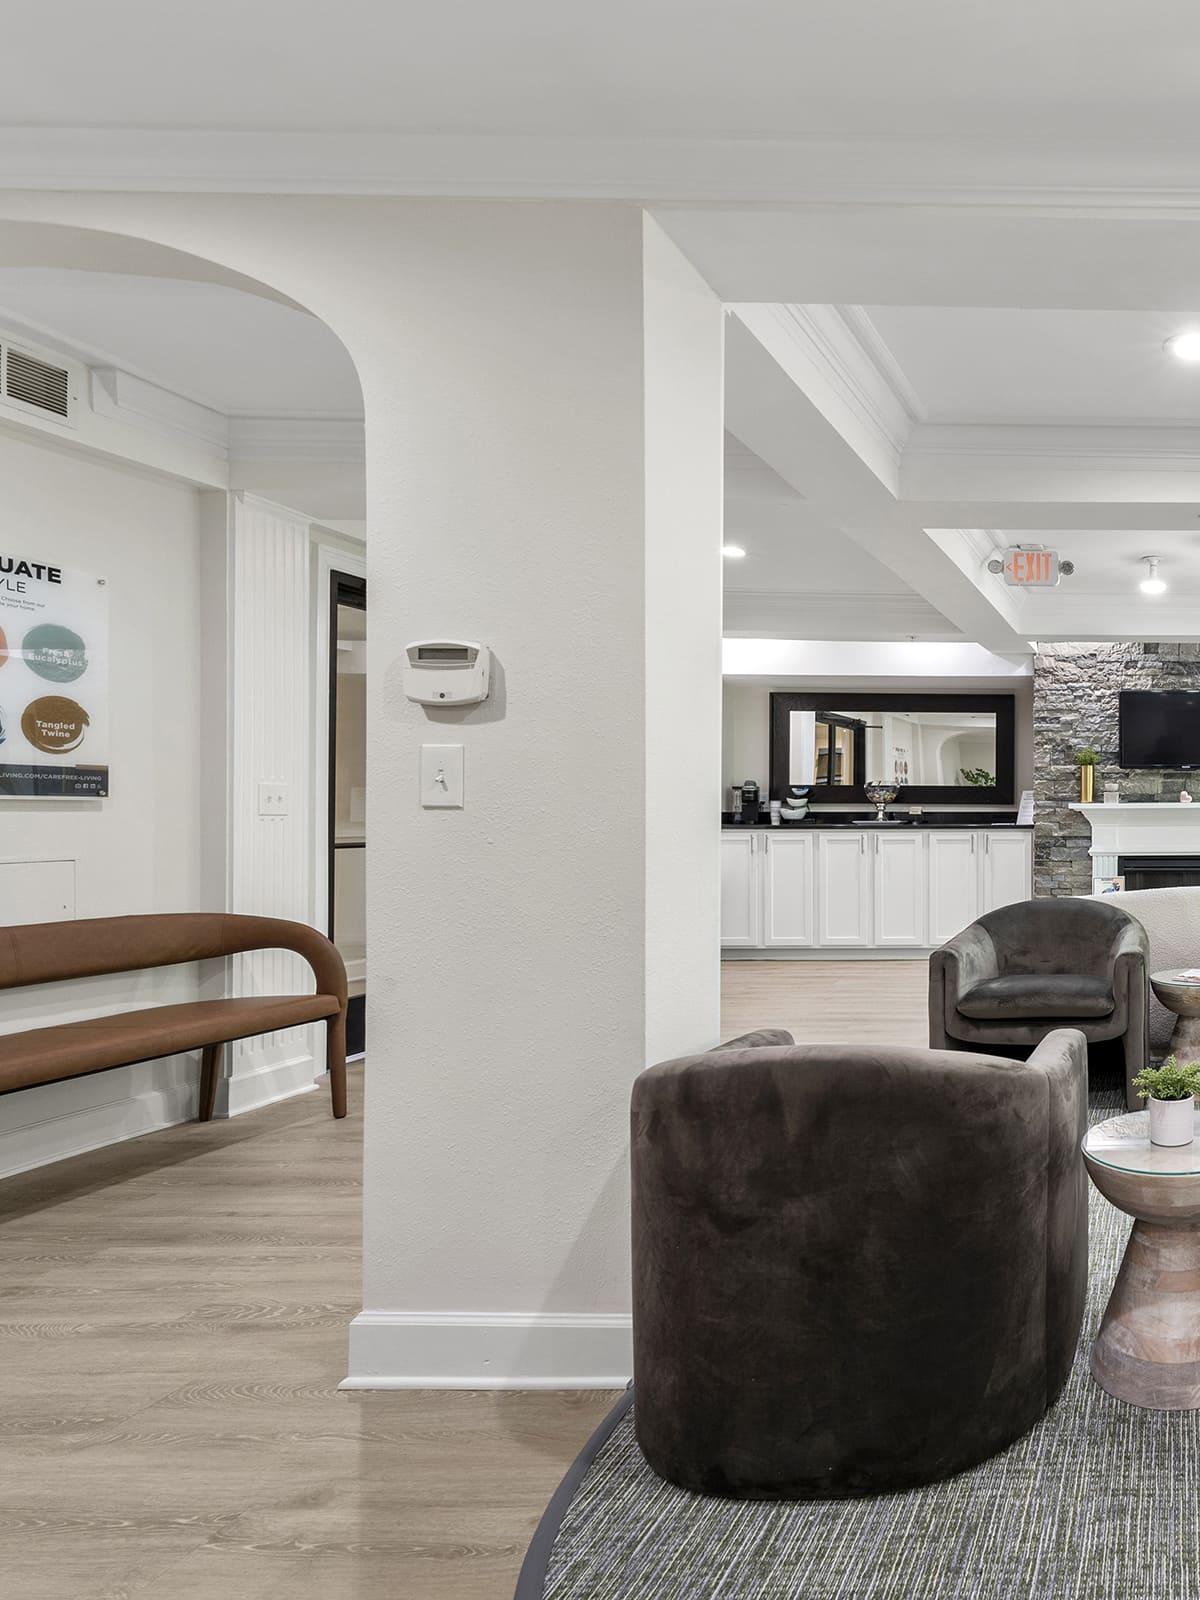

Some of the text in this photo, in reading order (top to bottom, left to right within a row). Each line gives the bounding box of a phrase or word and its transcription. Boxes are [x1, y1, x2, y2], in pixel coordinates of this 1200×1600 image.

[0, 556, 62, 585] UATE
[1013, 552, 1052, 582] EXIT
[28, 652, 83, 667] Eucalyptus
[36, 720, 75, 730] Tangled
[41, 729, 71, 738] Twine
